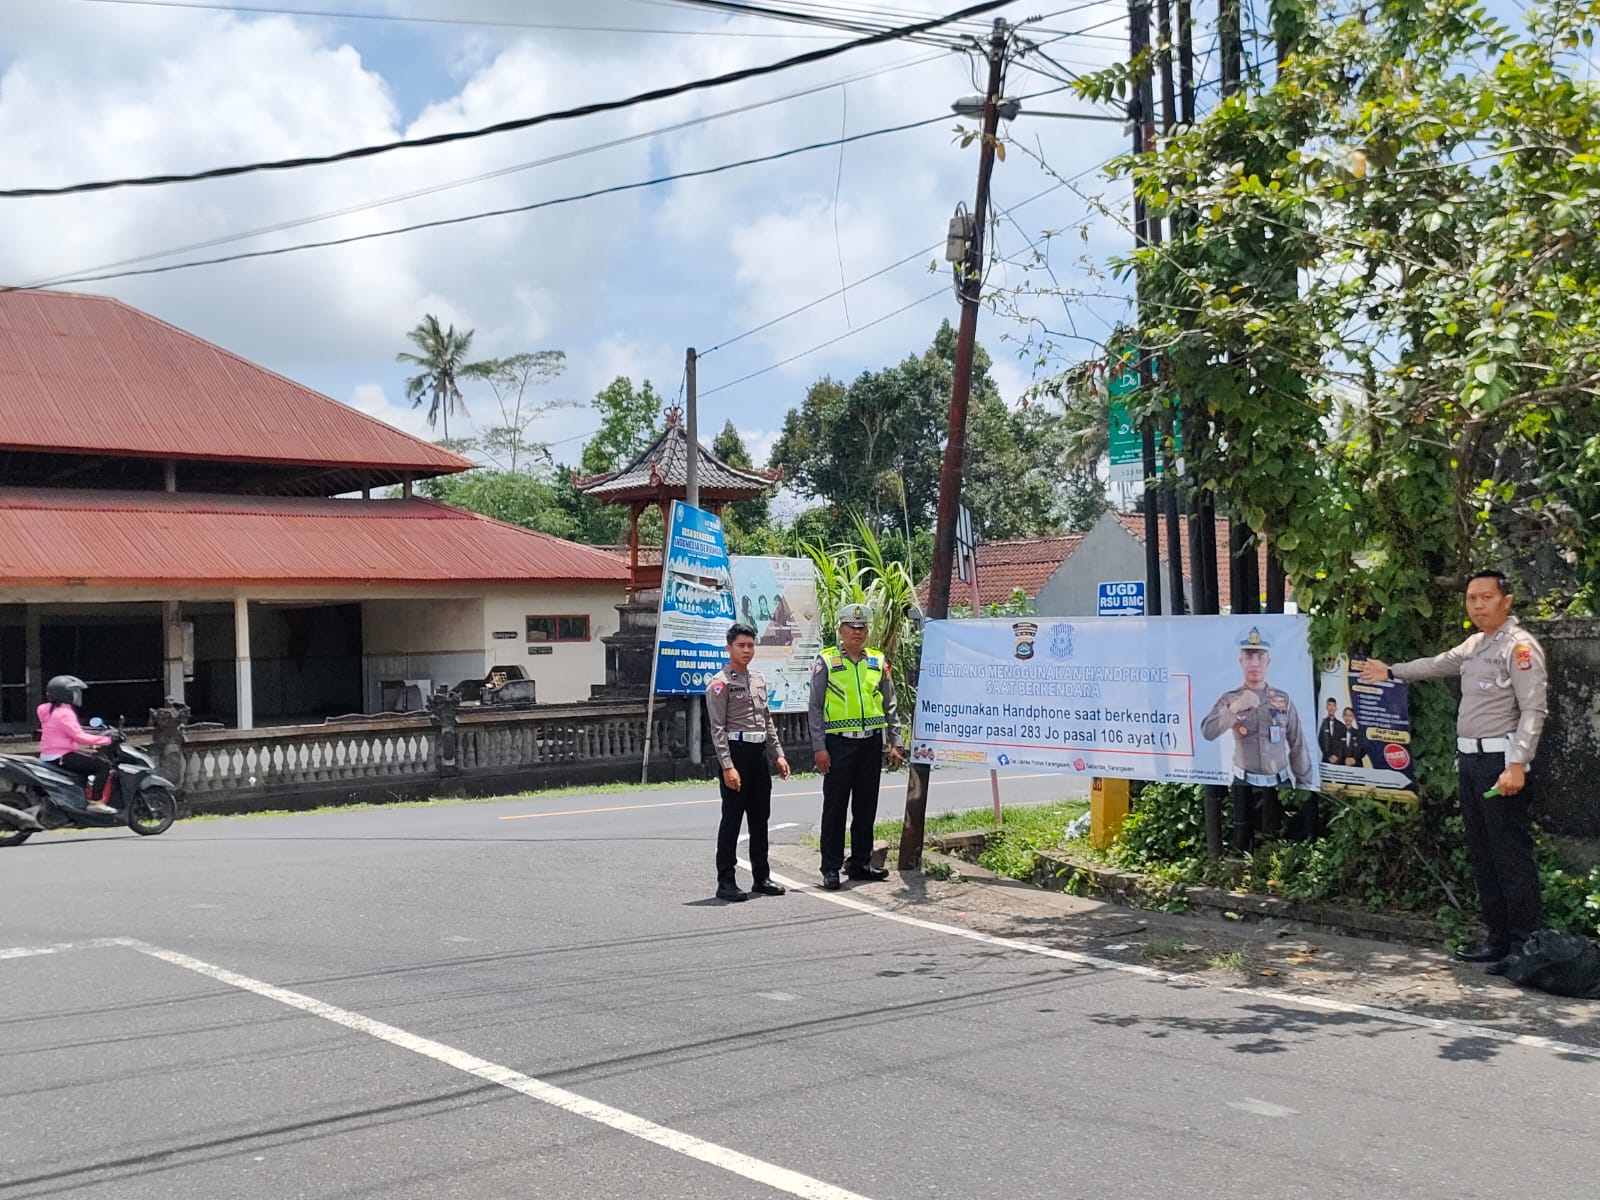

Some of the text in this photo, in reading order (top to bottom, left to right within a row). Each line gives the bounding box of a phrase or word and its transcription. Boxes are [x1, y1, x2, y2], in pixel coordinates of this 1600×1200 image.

[1106, 584, 1137, 596] UGD
[1100, 596, 1143, 607] RSU BMC
[929, 664, 1169, 683] DILARANG MENGGUNAKAN HANDPHONE
[986, 681, 1100, 698] SAAT BERKENDARA
[921, 699, 1180, 725] Menggunakan Handphone saat berkendara
[924, 721, 1178, 750] melanggar pasal 283 Jo pasal 106 ayat (1)
